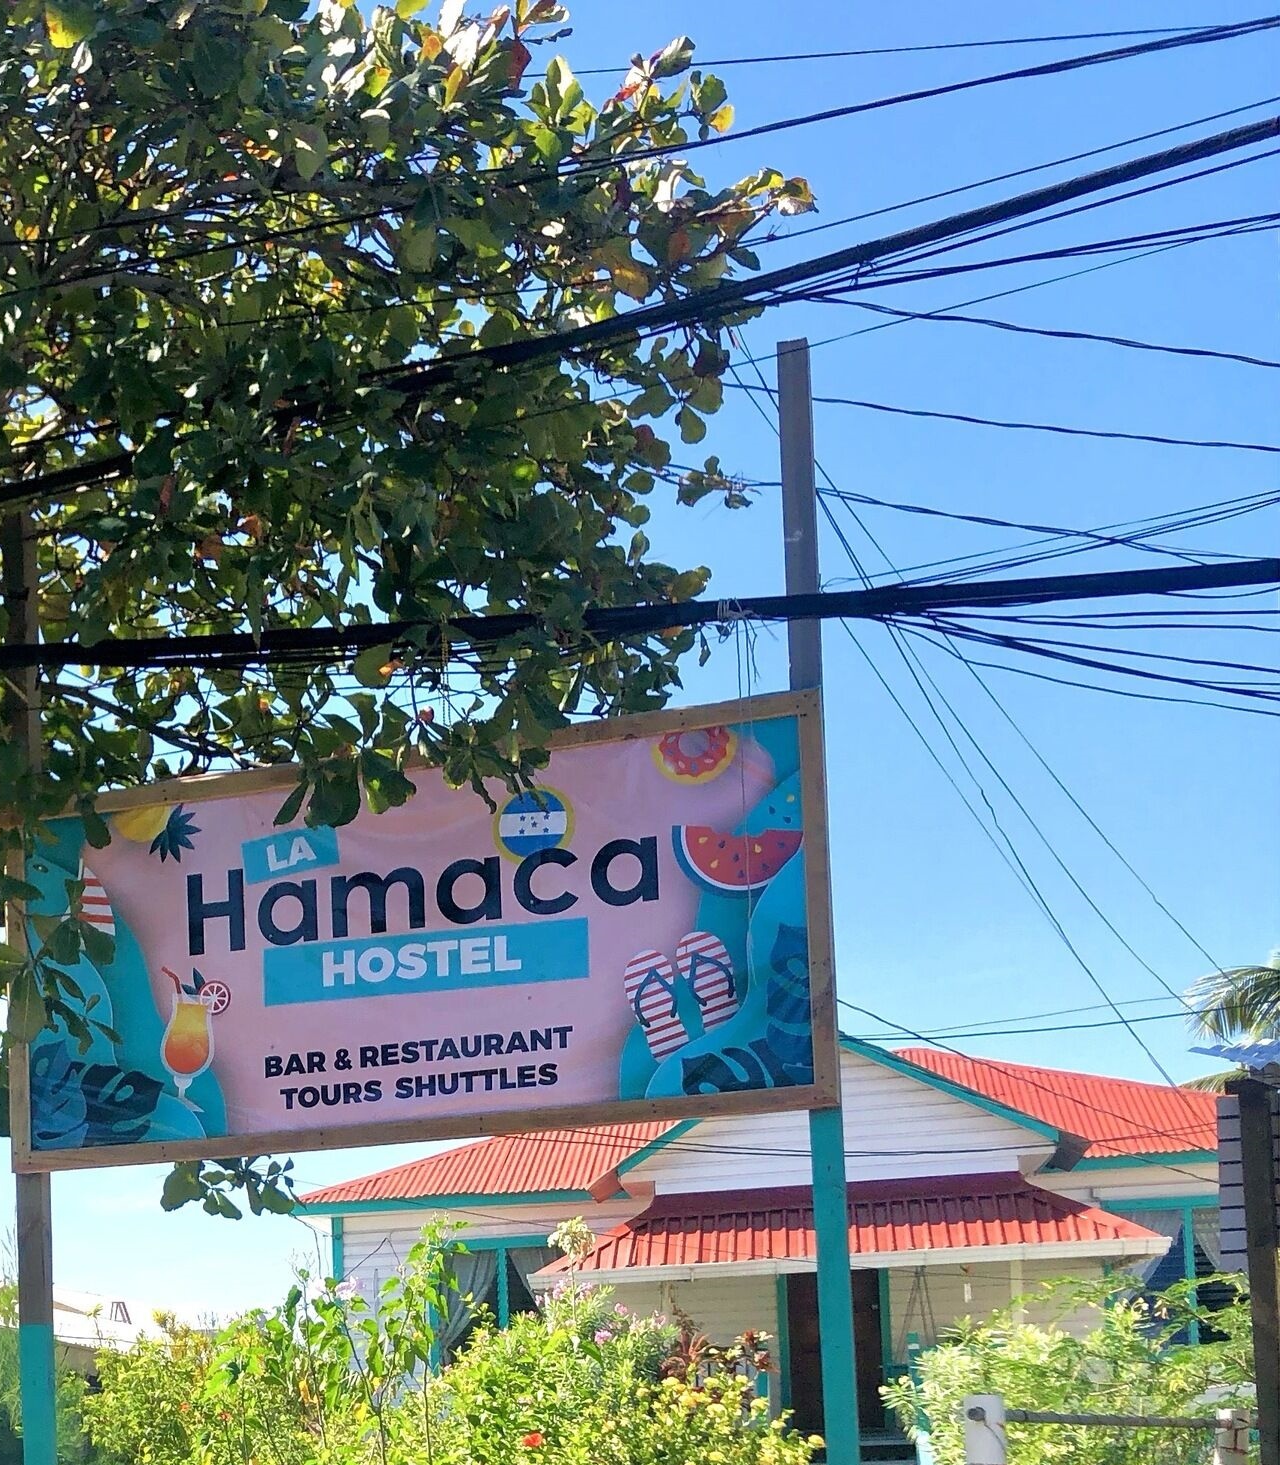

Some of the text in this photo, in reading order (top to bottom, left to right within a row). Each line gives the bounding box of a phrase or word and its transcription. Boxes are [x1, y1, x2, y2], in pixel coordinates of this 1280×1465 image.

[266, 836, 318, 873] LA
[187, 836, 660, 956] Hamaca
[322, 935, 523, 988] HOSTEL
[264, 1025, 574, 1079] BAR & RESTAURANT
[280, 1063, 559, 1110] TOURS SHUTTLES
